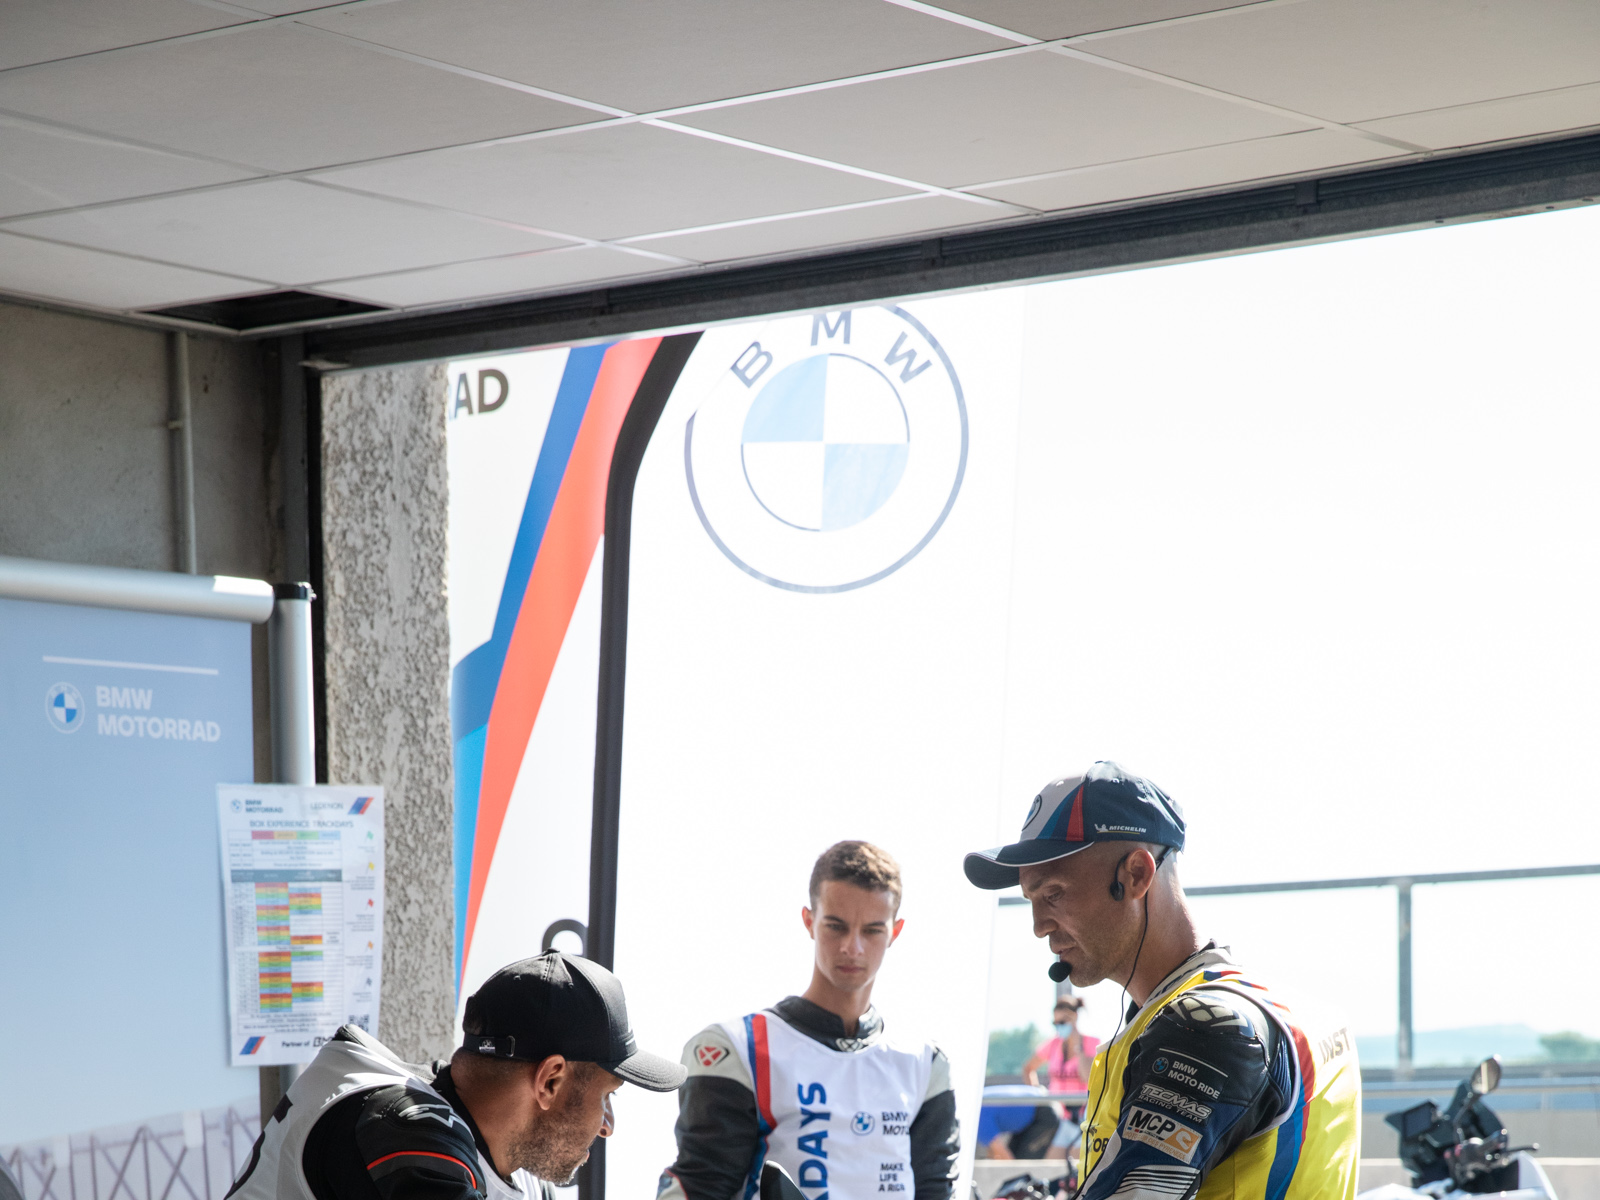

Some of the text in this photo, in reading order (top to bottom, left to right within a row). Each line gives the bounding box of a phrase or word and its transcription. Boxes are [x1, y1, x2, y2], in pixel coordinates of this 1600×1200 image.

[730, 310, 933, 388] BMW
[454, 368, 509, 419] AD
[96, 685, 153, 710] BMW
[97, 714, 221, 743] MOTORRAD
[1108, 825, 1147, 833] MICHELIN
[1172, 1061, 1198, 1076] BMW
[1167, 1070, 1220, 1100] MOTO RIDE
[1138, 1095, 1204, 1124] RACING TEAM
[1140, 1082, 1213, 1118] TECMAS
[1129, 1110, 1176, 1135] MCP
